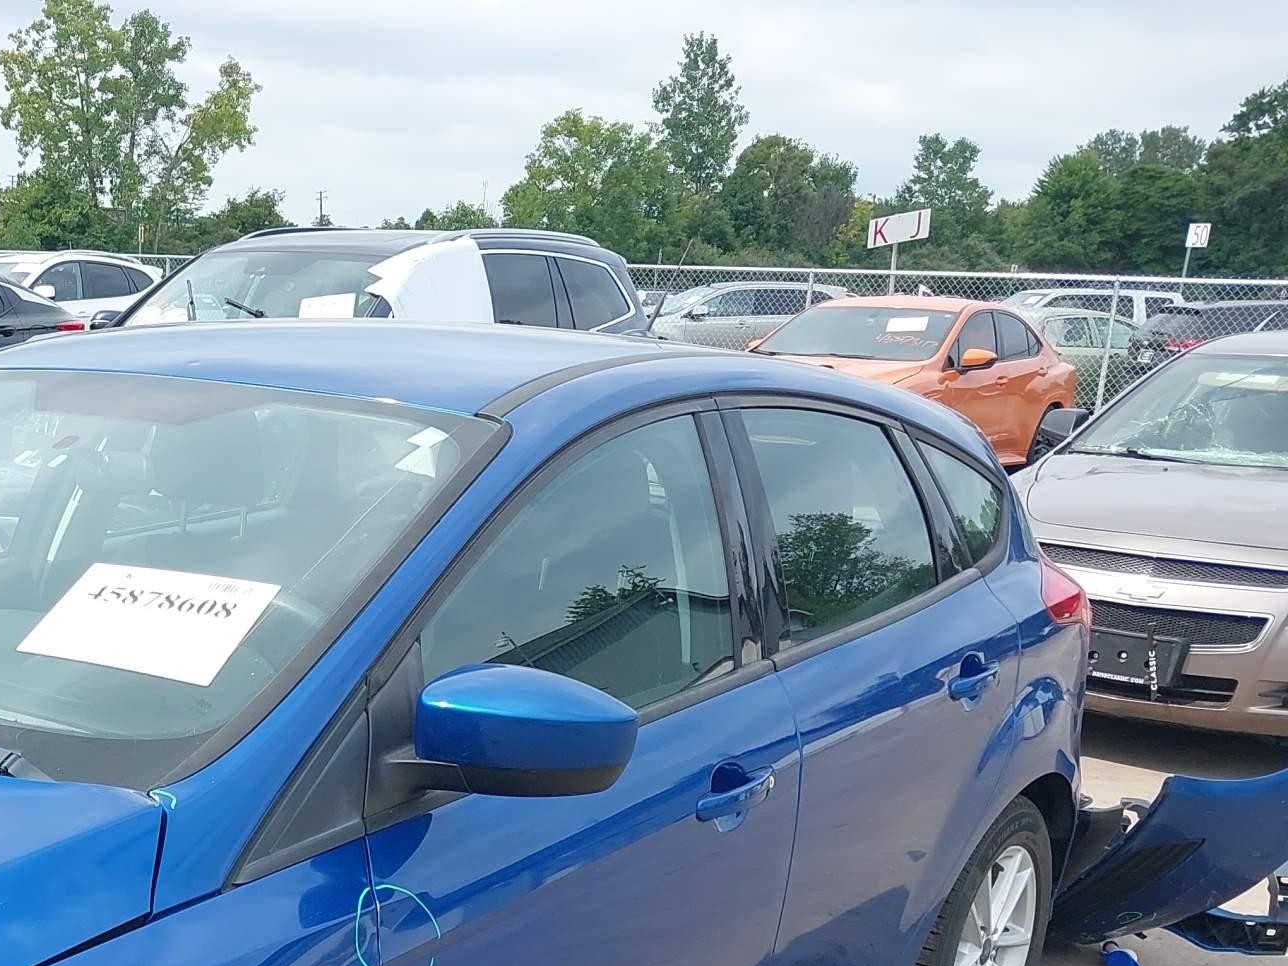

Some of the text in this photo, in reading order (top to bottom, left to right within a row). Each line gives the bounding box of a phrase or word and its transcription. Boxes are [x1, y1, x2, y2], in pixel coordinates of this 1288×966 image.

[873, 211, 921, 246] K J
[1192, 224, 1209, 246] 50
[87, 585, 238, 618] 45878608
[1148, 650, 1158, 691] CLASSIC
